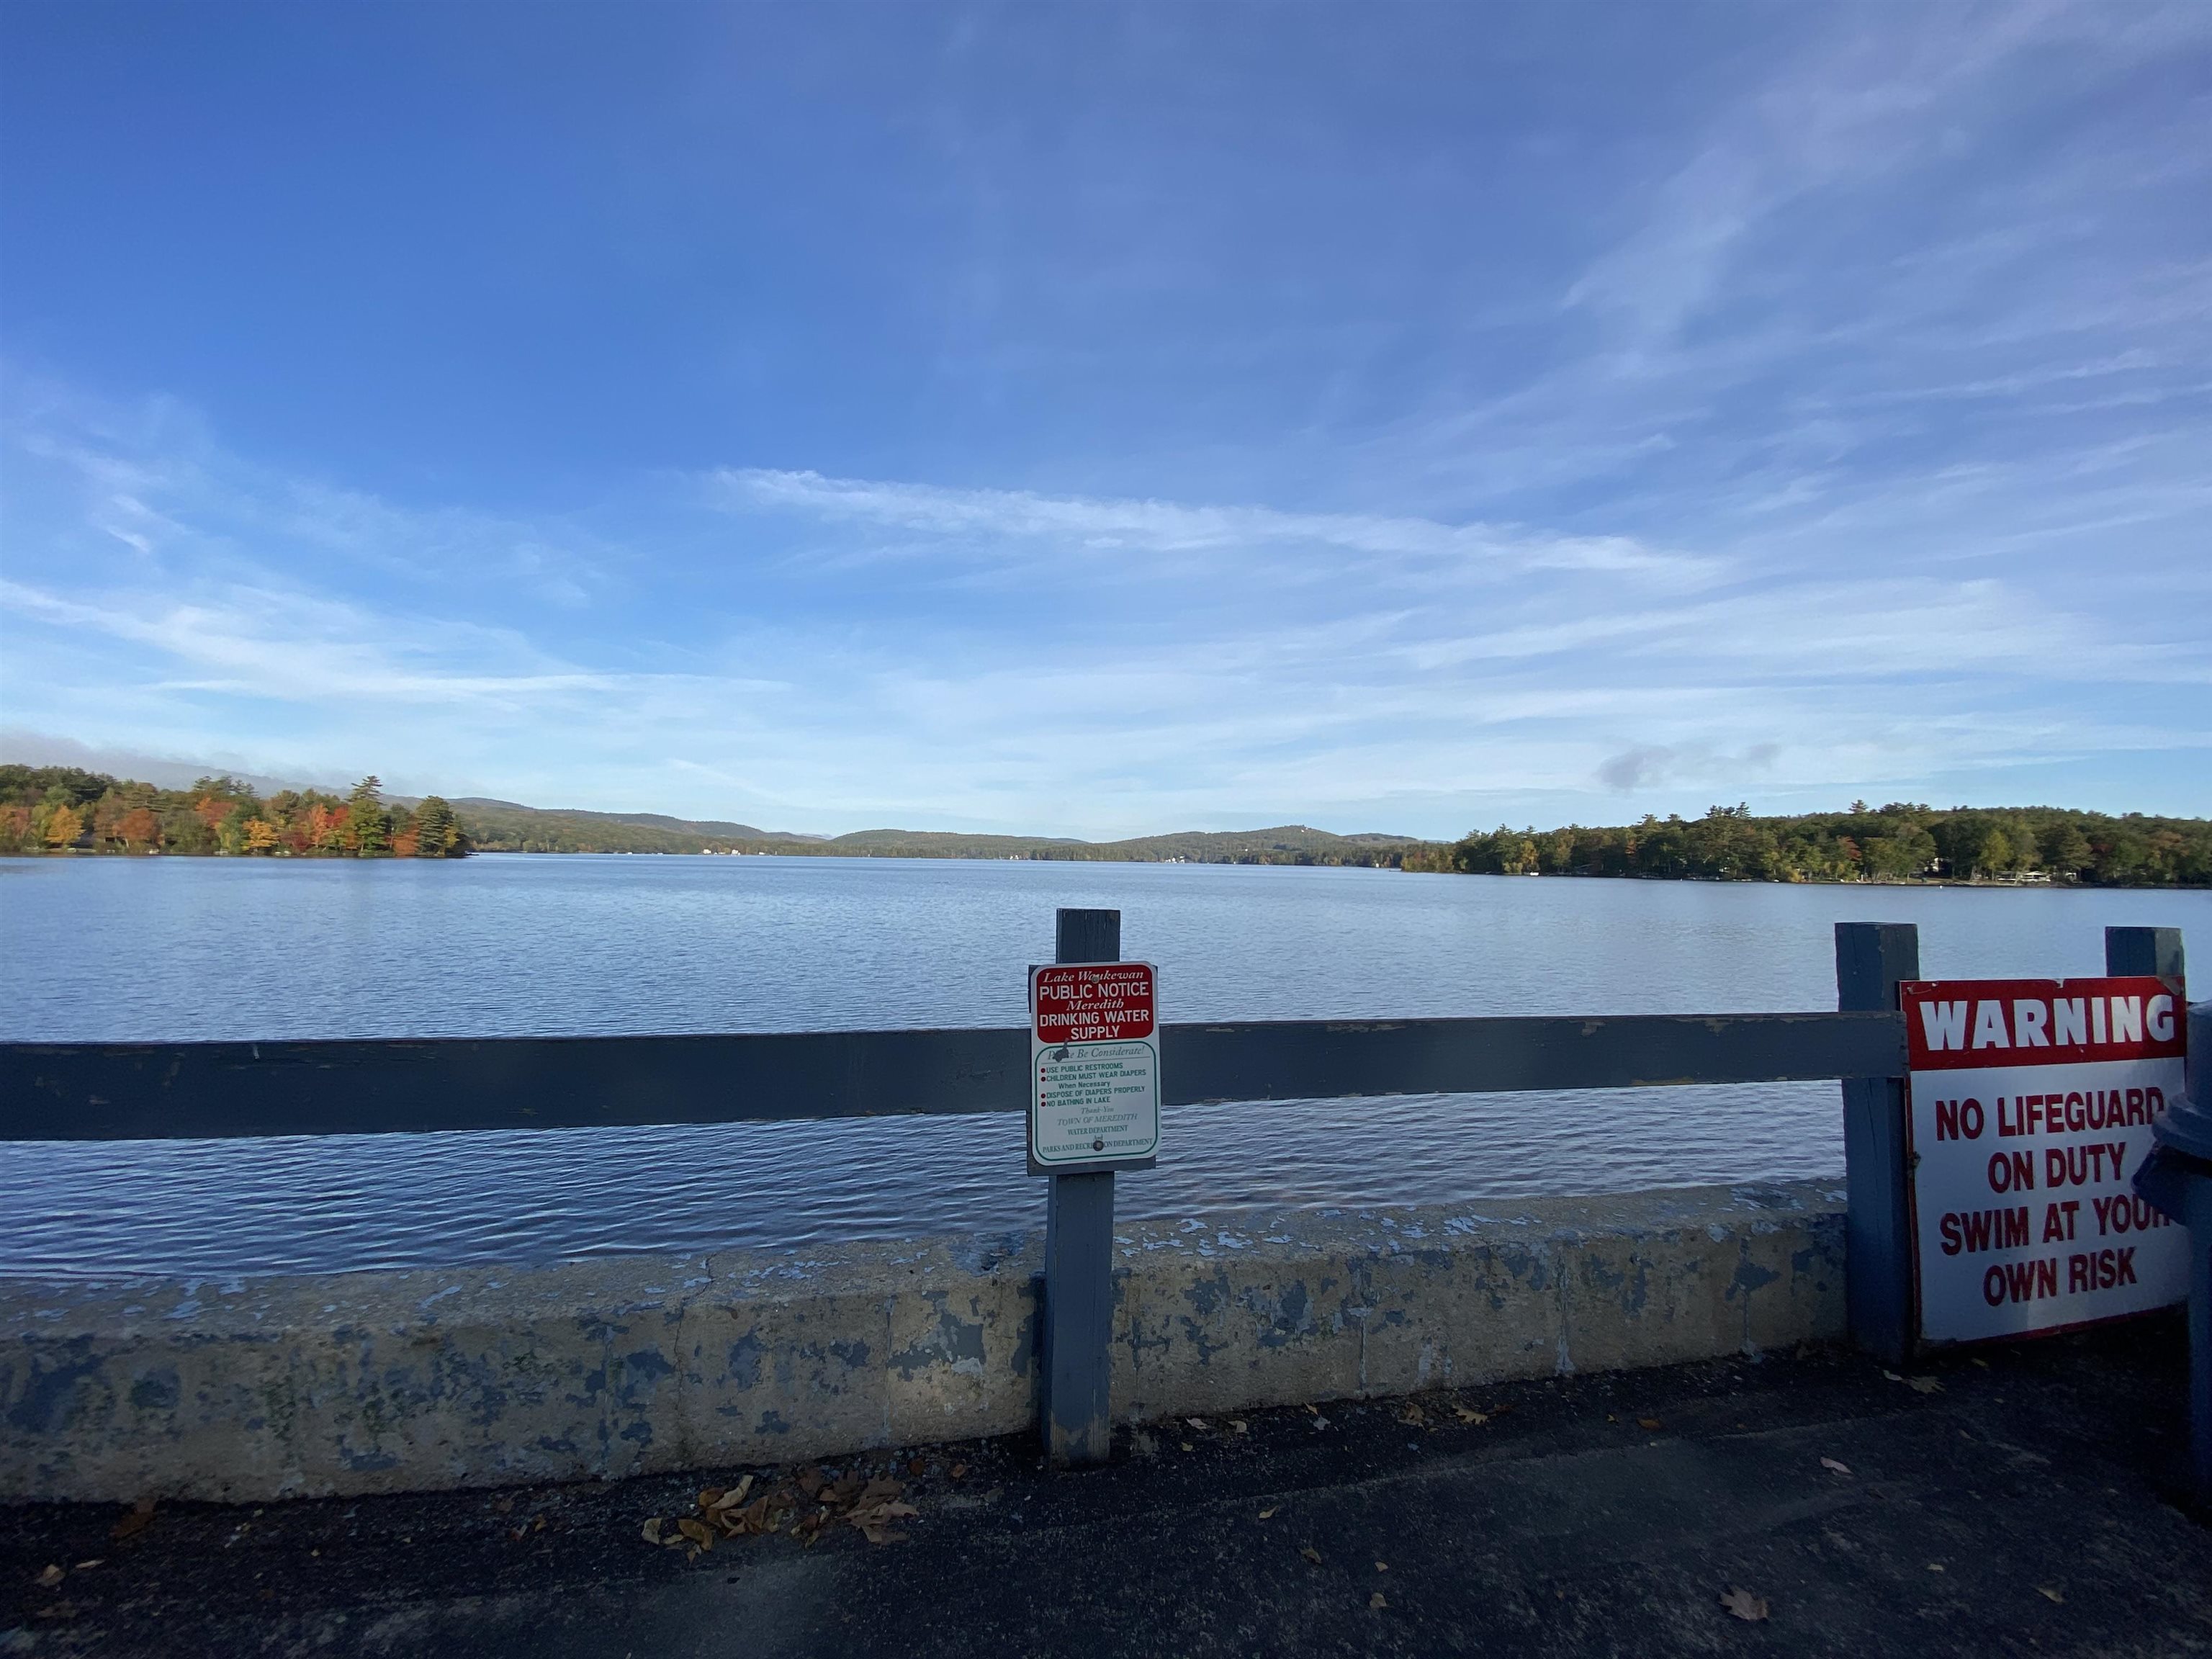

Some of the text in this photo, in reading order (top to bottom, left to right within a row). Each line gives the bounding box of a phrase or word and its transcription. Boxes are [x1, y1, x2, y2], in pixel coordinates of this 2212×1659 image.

[1043, 973, 1074, 982] Lake
[1040, 981, 1148, 1000] PUBLIC NOTICE
[1066, 999, 1124, 1010] Meredith
[1040, 1010, 1148, 1027] DRINKING WATER
[1920, 994, 2175, 1051] WARNING
[1071, 1025, 1120, 1040] SUPPLY
[1077, 1048, 1088, 1058] Be
[1091, 1046, 1146, 1057] Considerate!
[1057, 1118, 1082, 1126] TOWN
[1094, 1113, 1138, 1123] MEREDITH
[1936, 1087, 2165, 1141] NO LIFEGUARD
[1089, 1125, 1128, 1133] DEPARTMENT
[1113, 1138, 1153, 1148] DEPARTMENT
[1988, 1142, 2126, 1193] ON DUTY
[1939, 1207, 2029, 1255] SWIM
[2044, 1200, 2080, 1243] AT
[1983, 1246, 2137, 1305] OWN RISK
